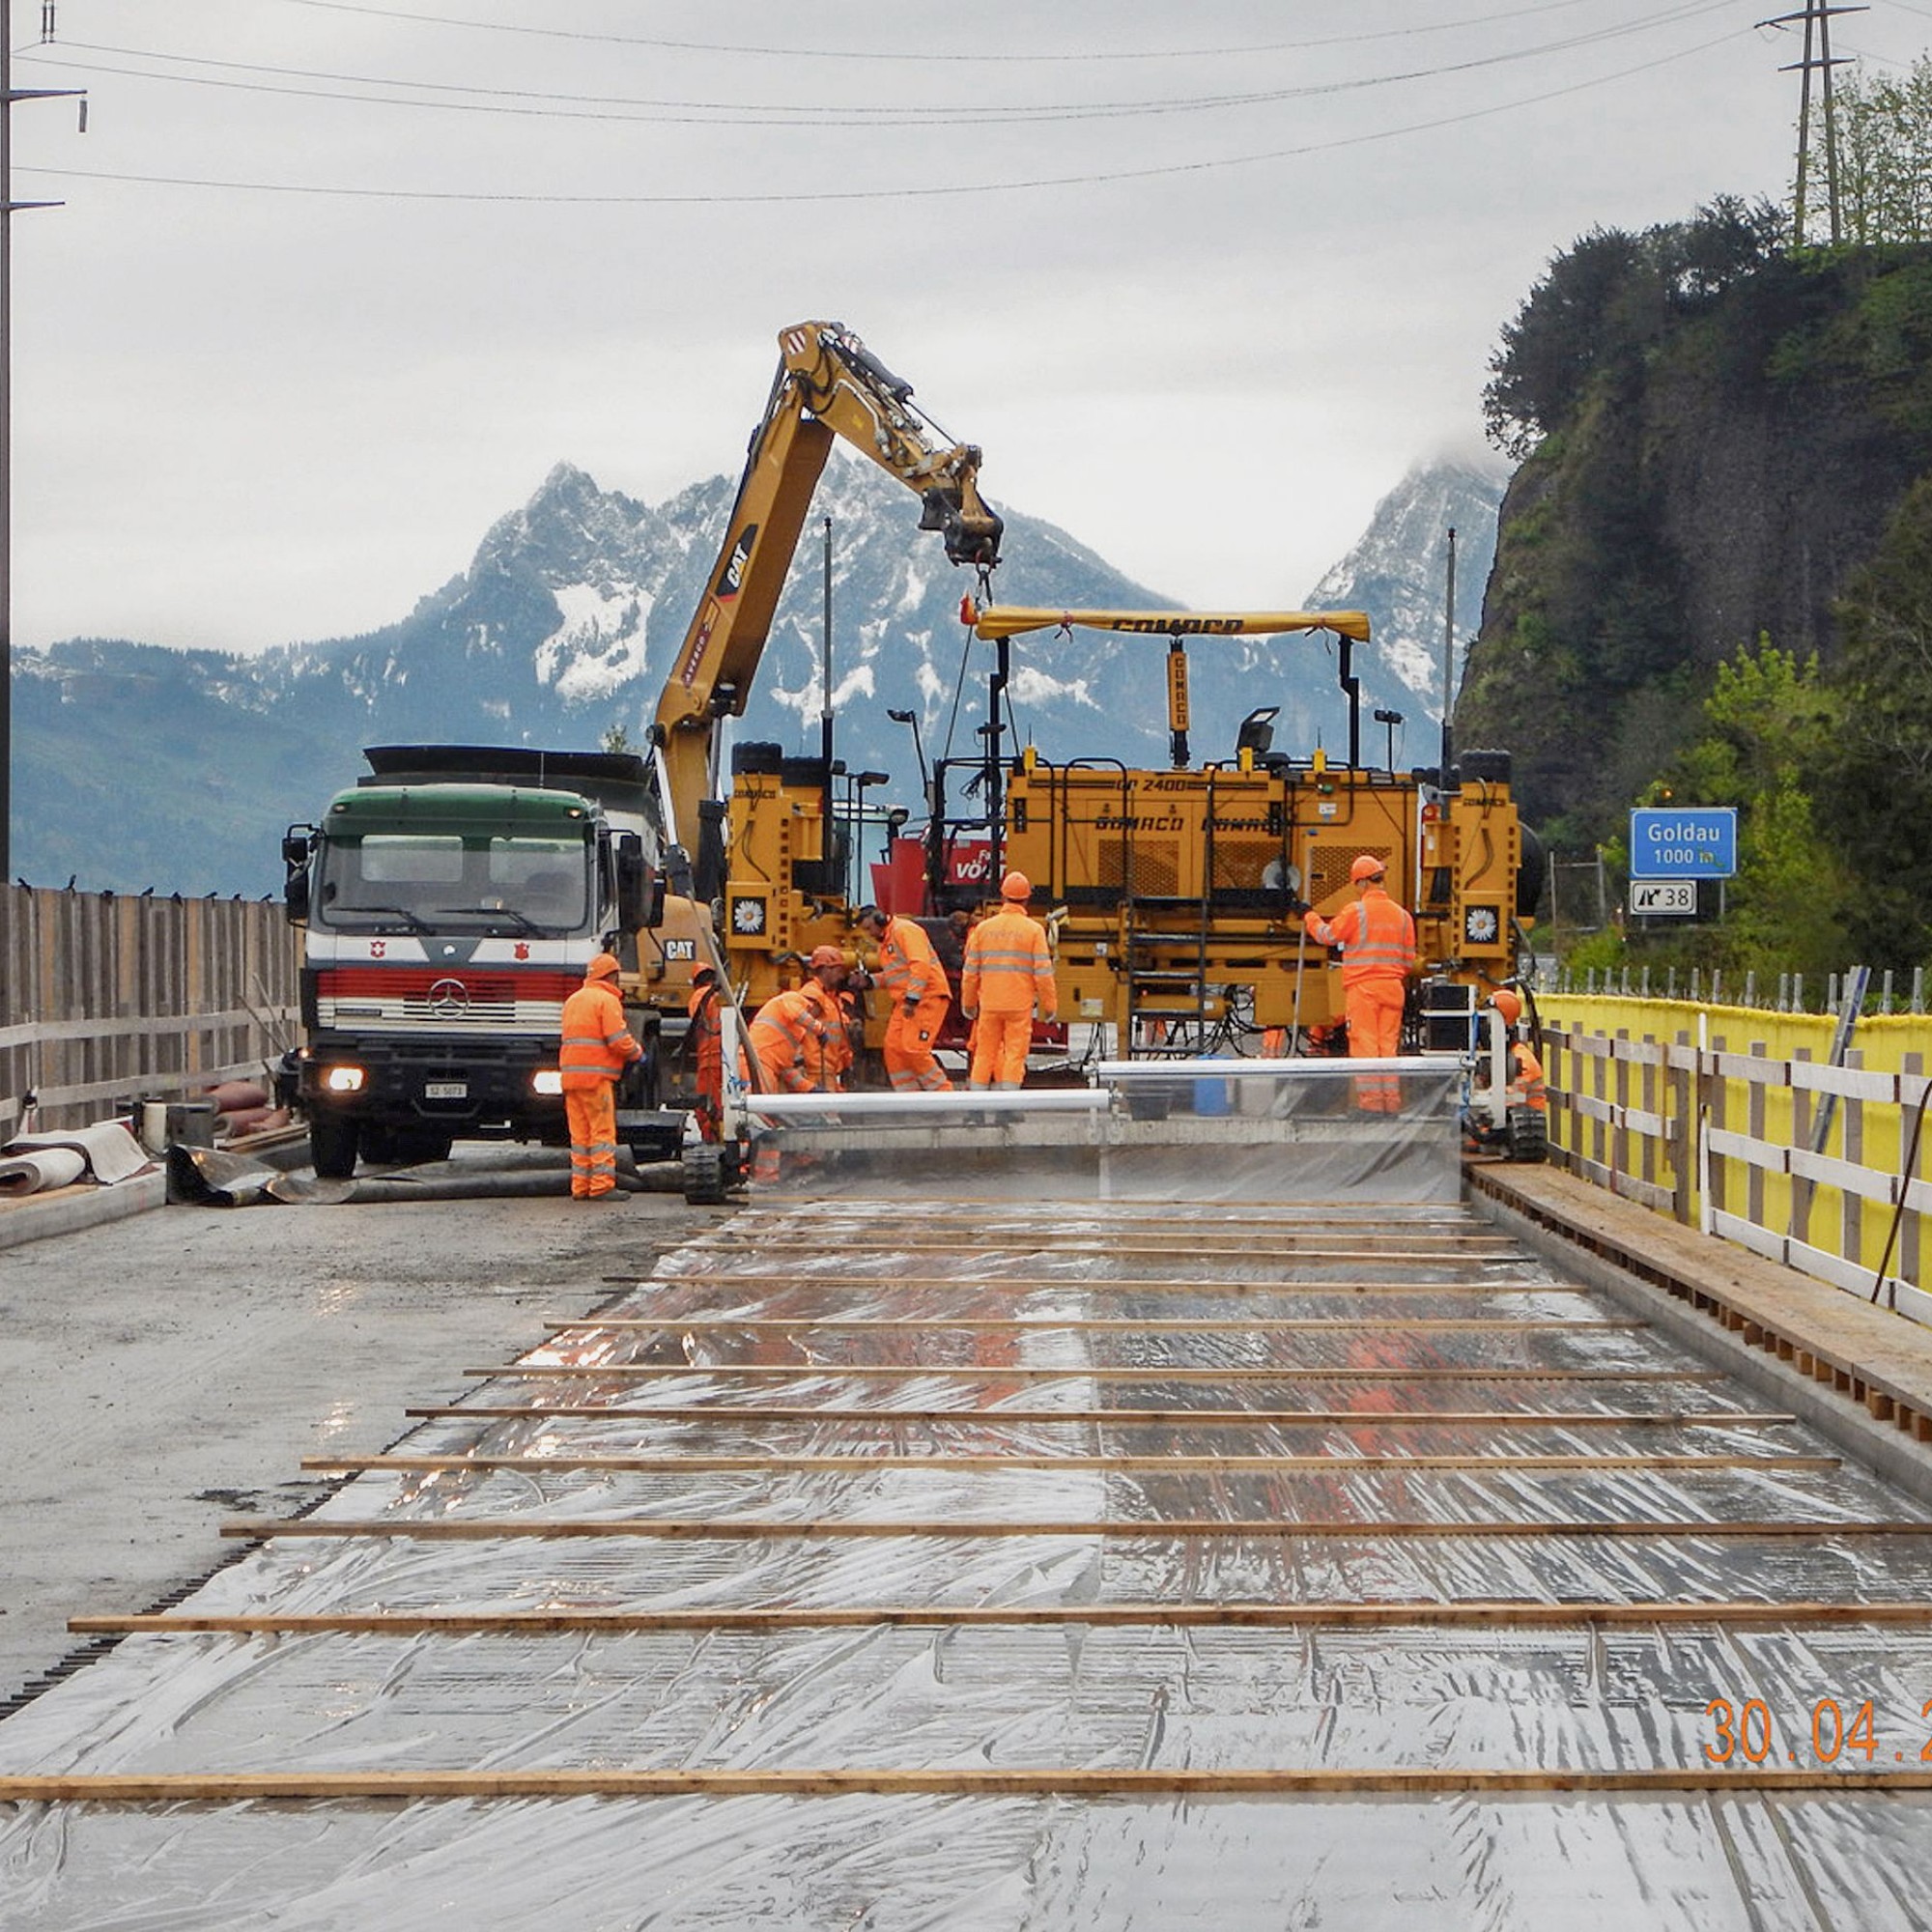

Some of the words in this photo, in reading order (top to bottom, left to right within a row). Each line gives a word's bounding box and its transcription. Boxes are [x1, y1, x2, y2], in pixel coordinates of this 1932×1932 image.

[726, 542, 749, 588] CAT
[1175, 658, 1186, 724] GOMACO
[1143, 780, 1187, 791] 2400
[1648, 822, 1719, 842] Goldau
[1655, 849, 1693, 864] 1000
[1699, 851, 1715, 864] m
[1665, 889, 1689, 906] 38
[667, 940, 694, 959] CAT
